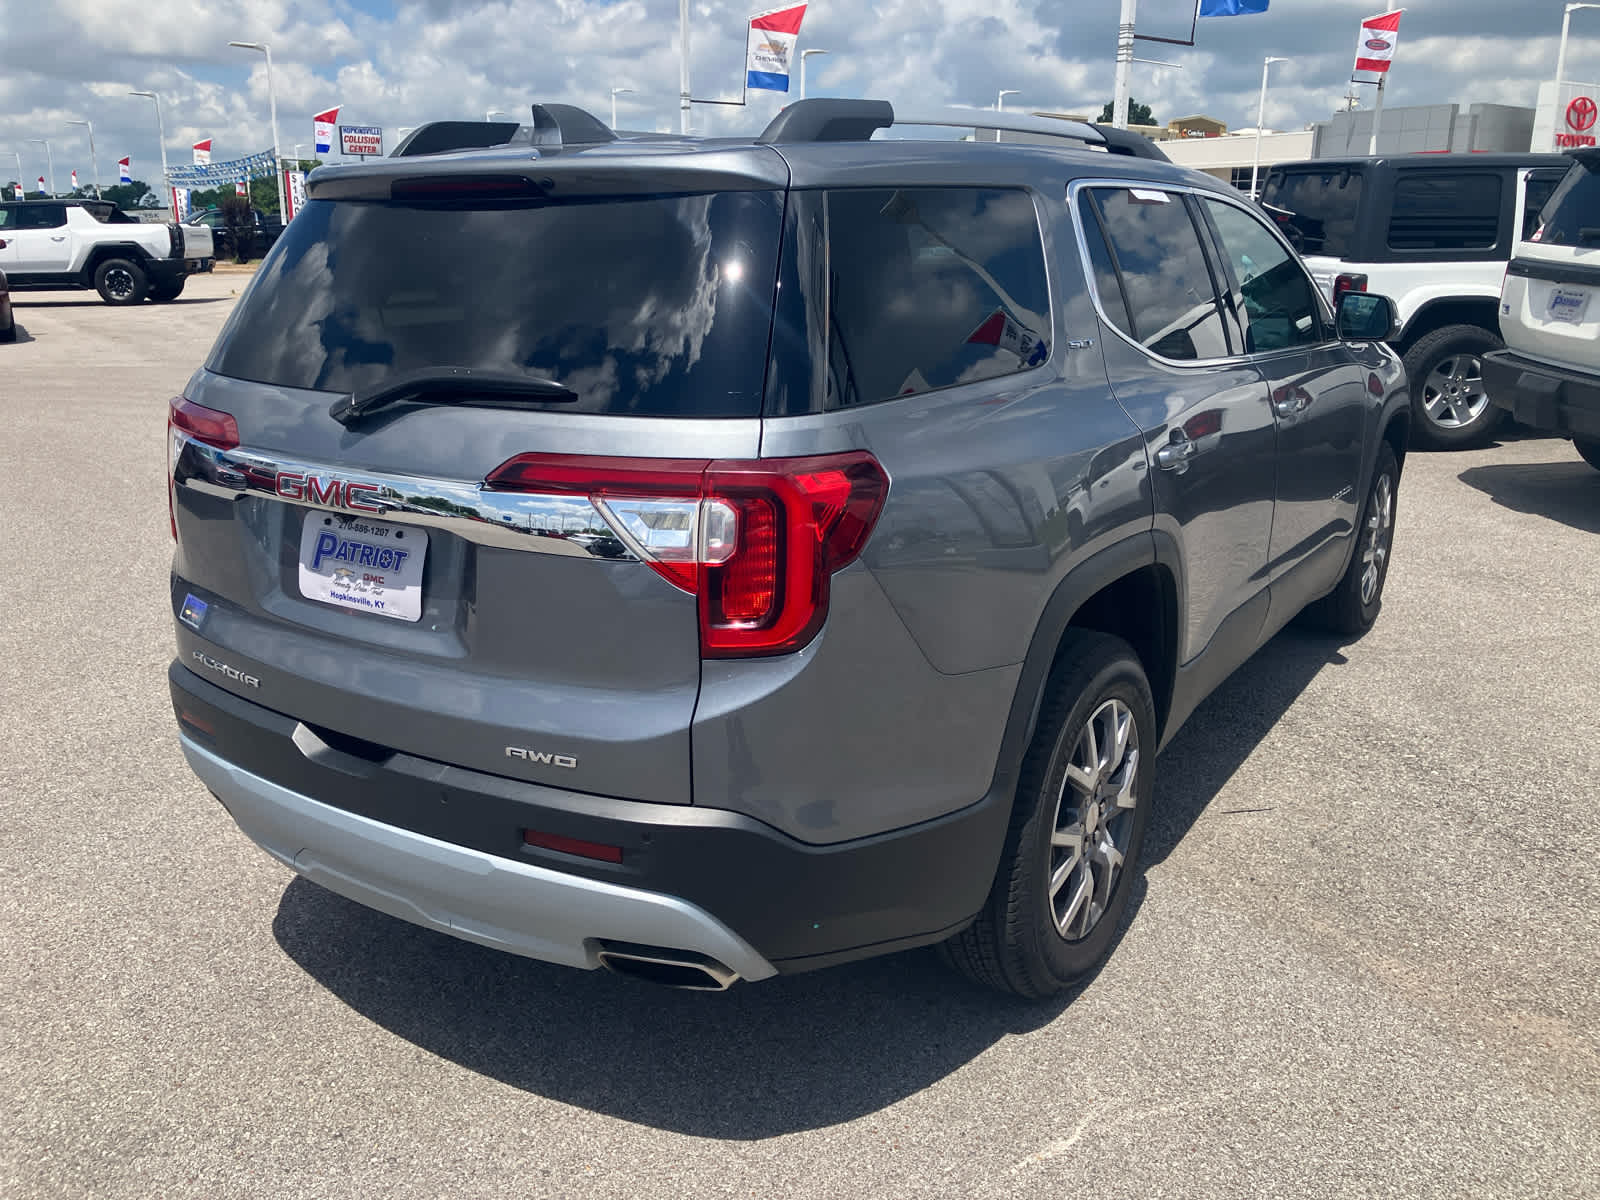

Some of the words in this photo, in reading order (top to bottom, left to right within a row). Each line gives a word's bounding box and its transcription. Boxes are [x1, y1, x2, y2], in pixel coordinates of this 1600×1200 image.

[343, 127, 380, 135] HOPKINSVILLE
[343, 135, 381, 145] COLLISION
[1555, 133, 1596, 147] TOYOTA
[349, 145, 377, 154] CENTER
[275, 471, 380, 514] GMC
[312, 531, 408, 571] PATRIOT
[330, 590, 373, 608] Hopkinsville,
[374, 600, 385, 609] KY
[192, 651, 261, 688] ACADIA
[505, 746, 577, 769] AWD
